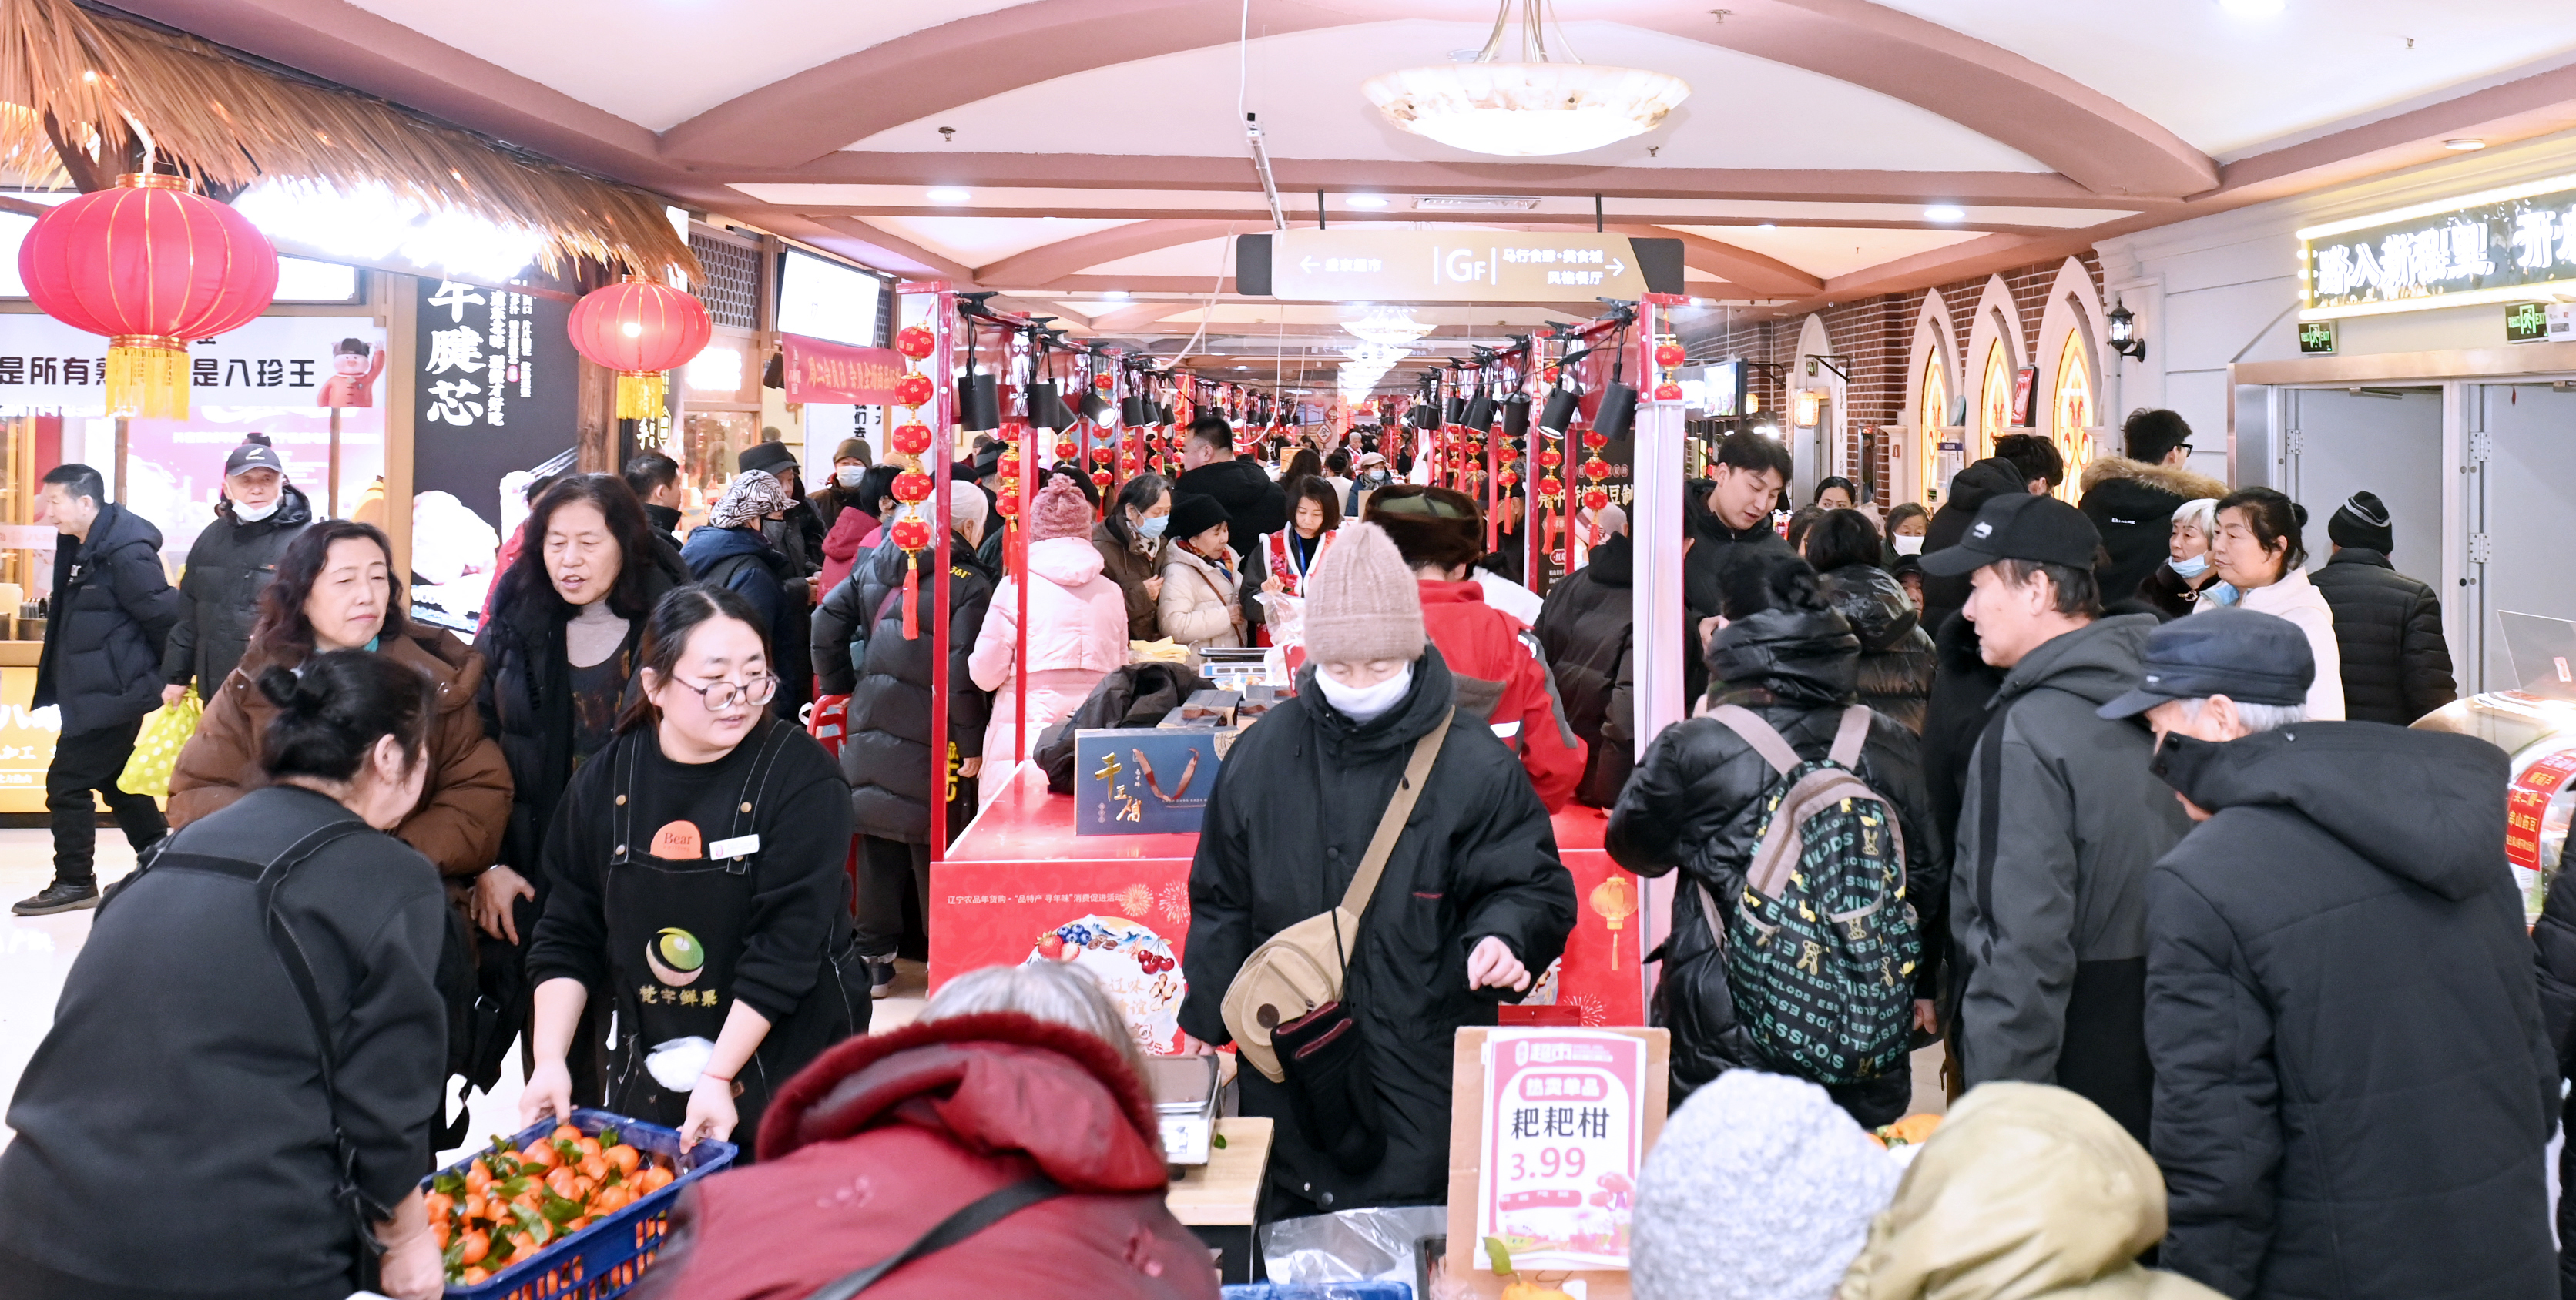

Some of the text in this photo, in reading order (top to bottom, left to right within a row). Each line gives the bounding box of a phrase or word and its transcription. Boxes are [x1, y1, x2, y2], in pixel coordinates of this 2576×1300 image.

[1547, 270, 1604, 285] 风格餐厅
[664, 833, 693, 846] Bear
[1510, 1146, 1587, 1181] 3.99
